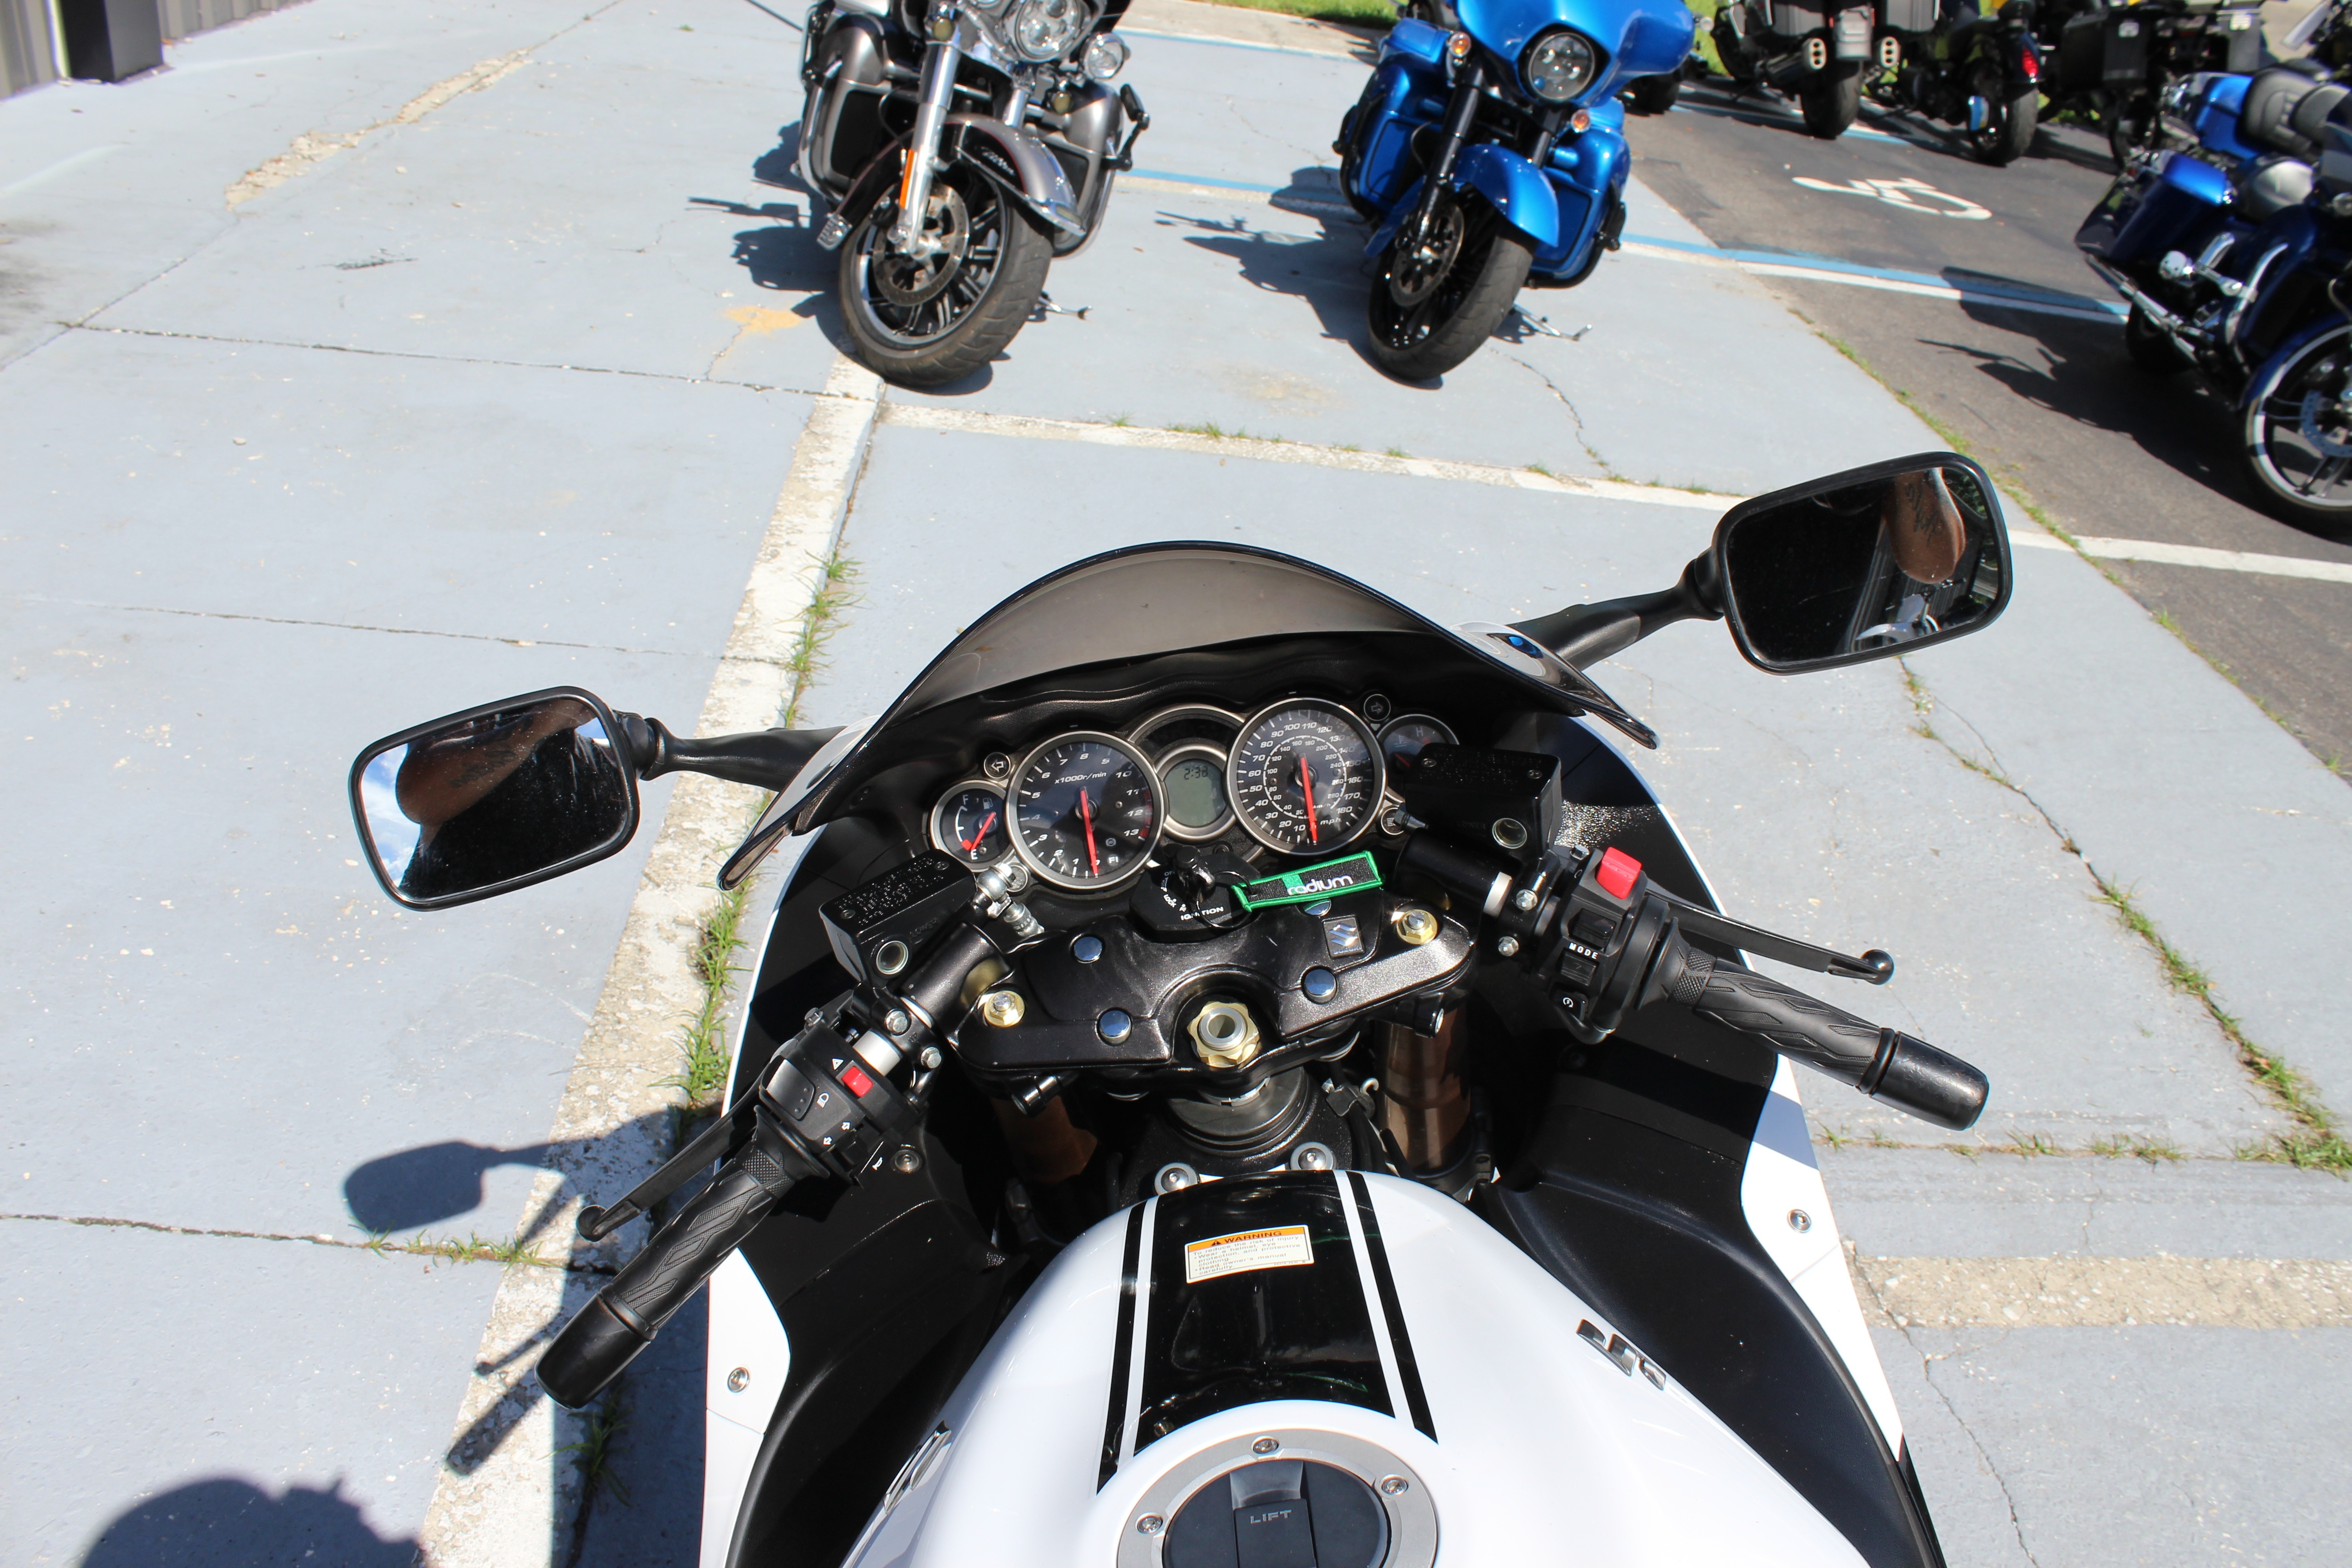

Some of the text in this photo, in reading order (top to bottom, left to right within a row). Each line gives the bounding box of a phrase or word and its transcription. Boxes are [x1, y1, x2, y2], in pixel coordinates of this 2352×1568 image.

[1416, 726, 1423, 737] H
[1253, 754, 1265, 762] 70
[1055, 772, 1107, 784] x1000r/min
[1250, 784, 1263, 793] 50
[963, 795, 968, 805] F
[1343, 792, 1360, 800] 170
[1336, 806, 1352, 814] 180
[1279, 820, 1292, 828] 20
[970, 849, 978, 860] E
[1287, 875, 1353, 896] radium
[1163, 894, 1177, 908] LOCK
[1568, 942, 1598, 959] MODE
[1224, 1231, 1282, 1243] WARNING
[1223, 1257, 1254, 1265] owner's
[1250, 1509, 1292, 1524] LIFT
